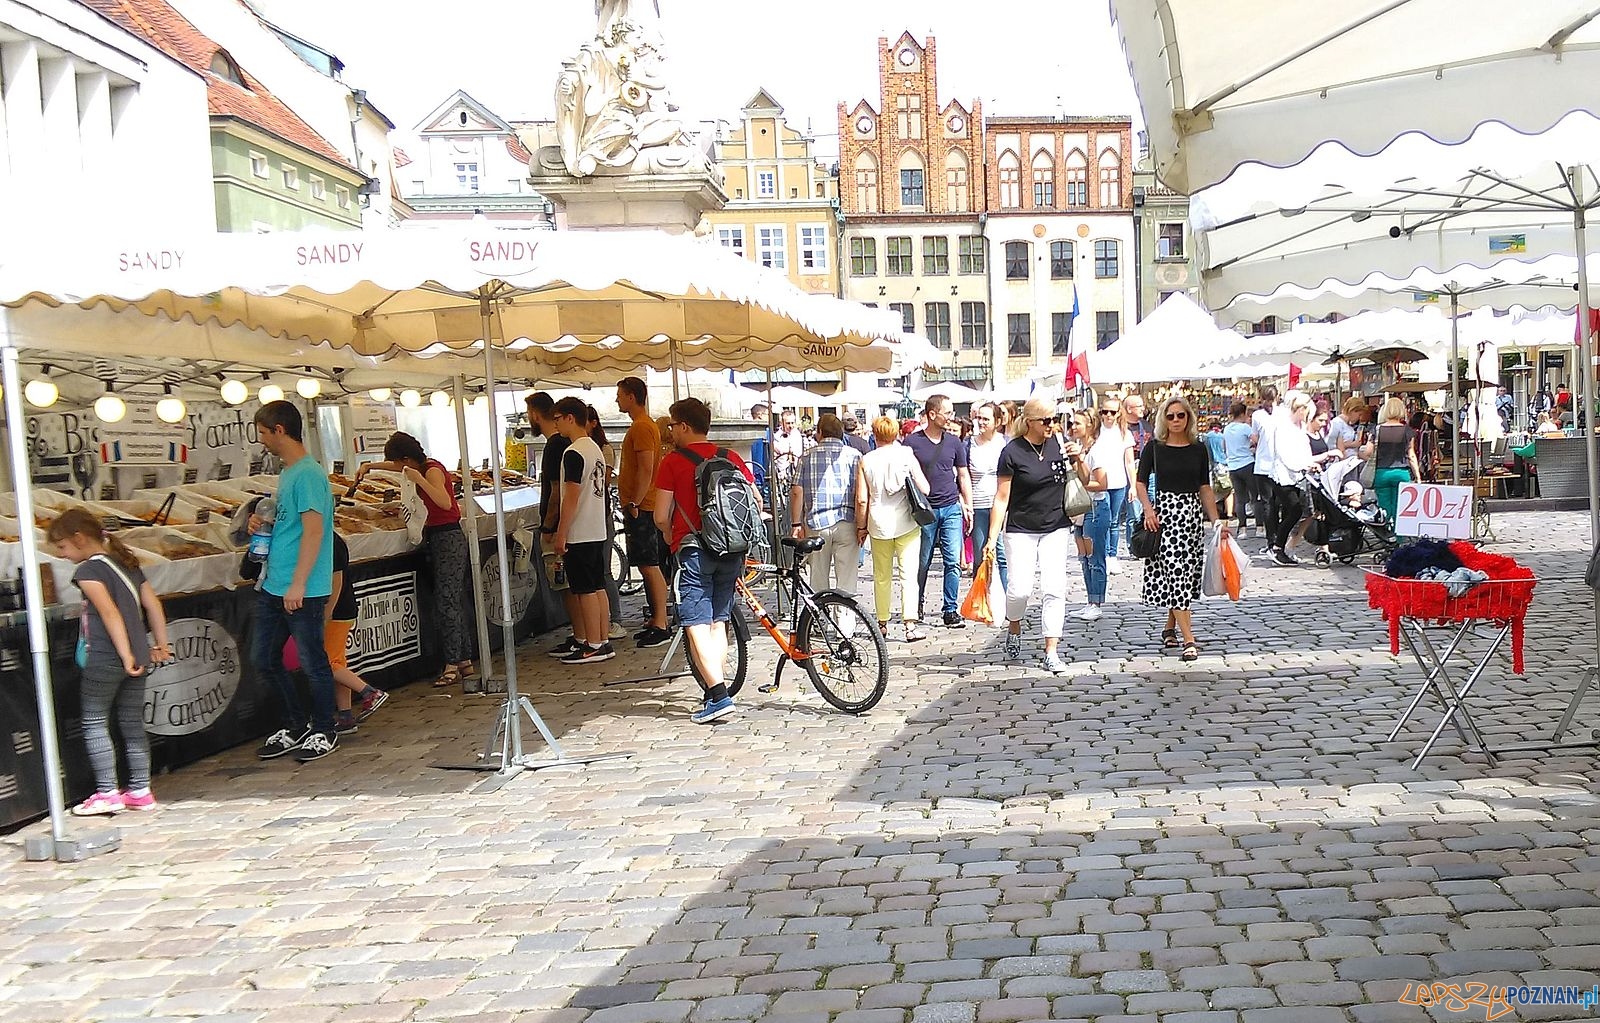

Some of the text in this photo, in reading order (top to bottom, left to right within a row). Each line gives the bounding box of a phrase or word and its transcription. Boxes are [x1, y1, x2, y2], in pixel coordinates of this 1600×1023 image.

[119, 250, 185, 272] SANDY
[297, 243, 364, 266] SANDY
[470, 241, 539, 262] SANDY
[803, 344, 840, 357] SANDY
[186, 409, 260, 451] d'anta
[1399, 486, 1469, 519] 20zł
